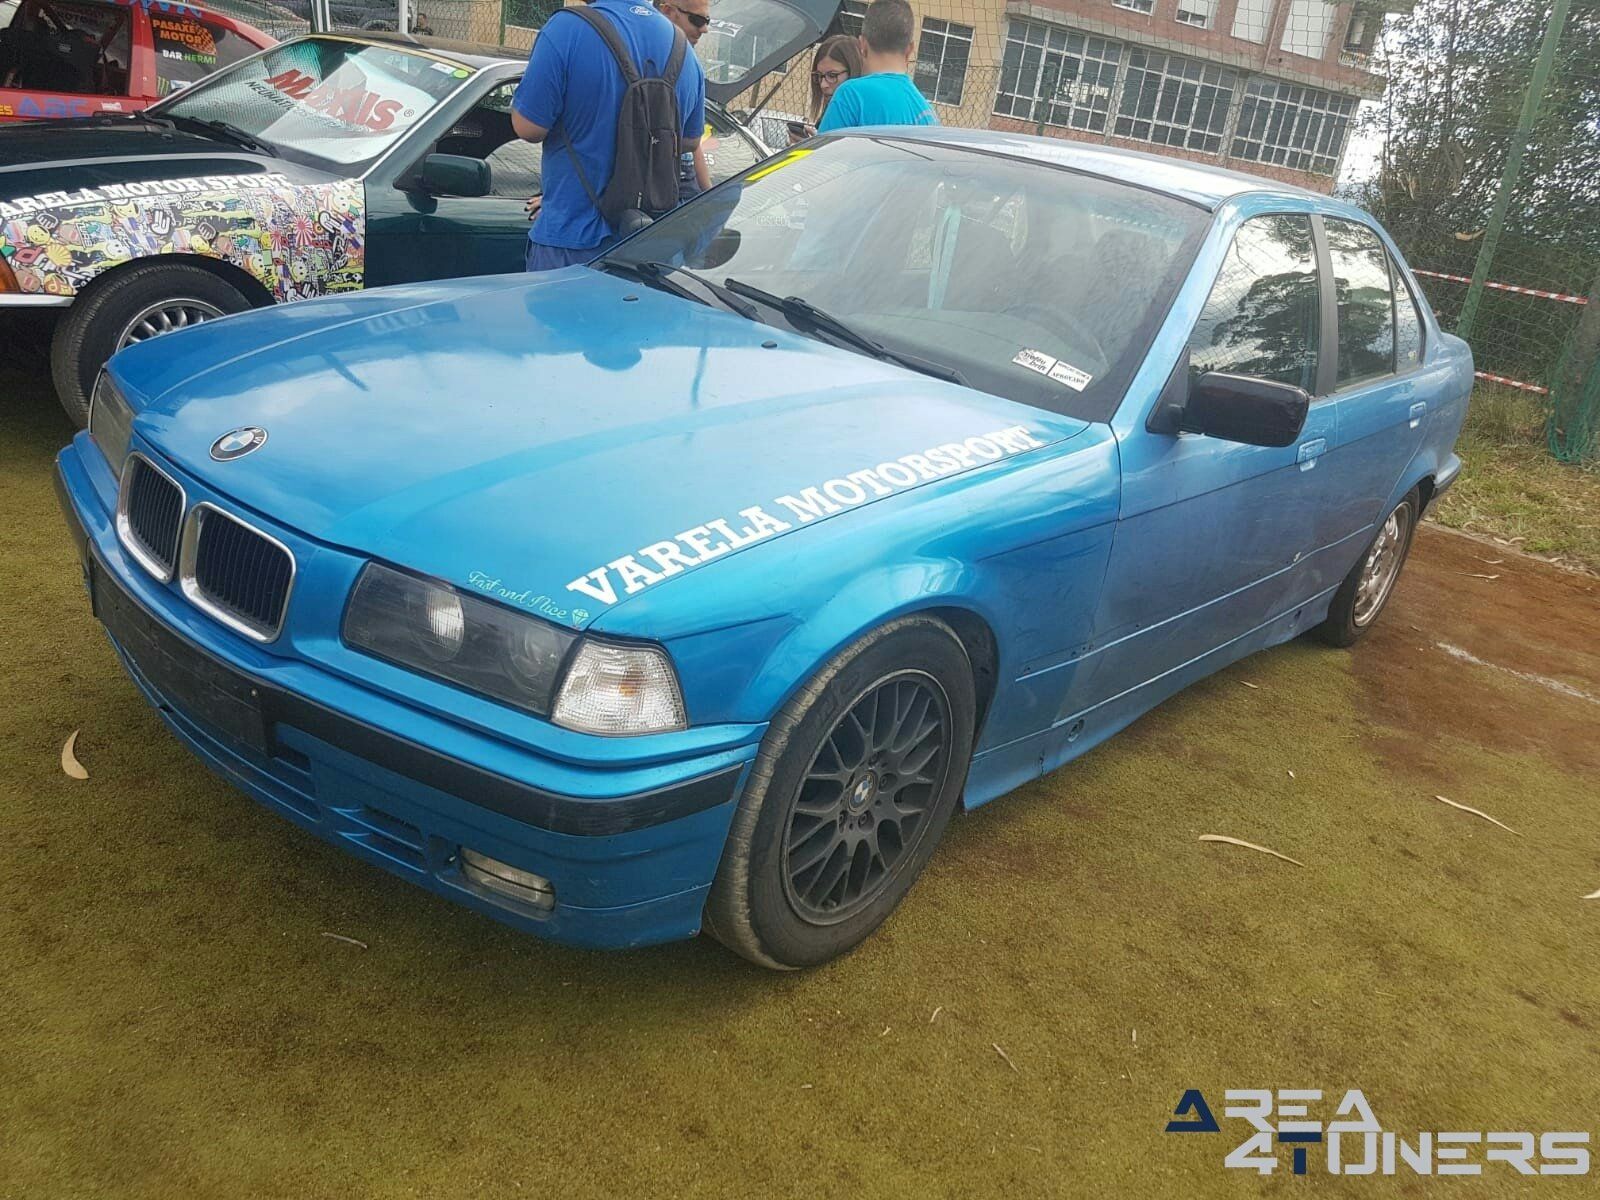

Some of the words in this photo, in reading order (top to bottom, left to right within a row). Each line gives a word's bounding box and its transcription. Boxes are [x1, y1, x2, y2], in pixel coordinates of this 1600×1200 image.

[152, 20, 195, 34] PASAXE
[160, 31, 202, 44] MOTOR
[162, 49, 183, 60] BAR
[98, 177, 207, 198] MOTOR
[205, 174, 293, 190] SPORT
[566, 496, 790, 606] VARELA
[774, 425, 1043, 522] MOTORSPORT
[468, 570, 502, 593] Fast
[497, 588, 532, 604] and
[528, 594, 568, 619] Nice
